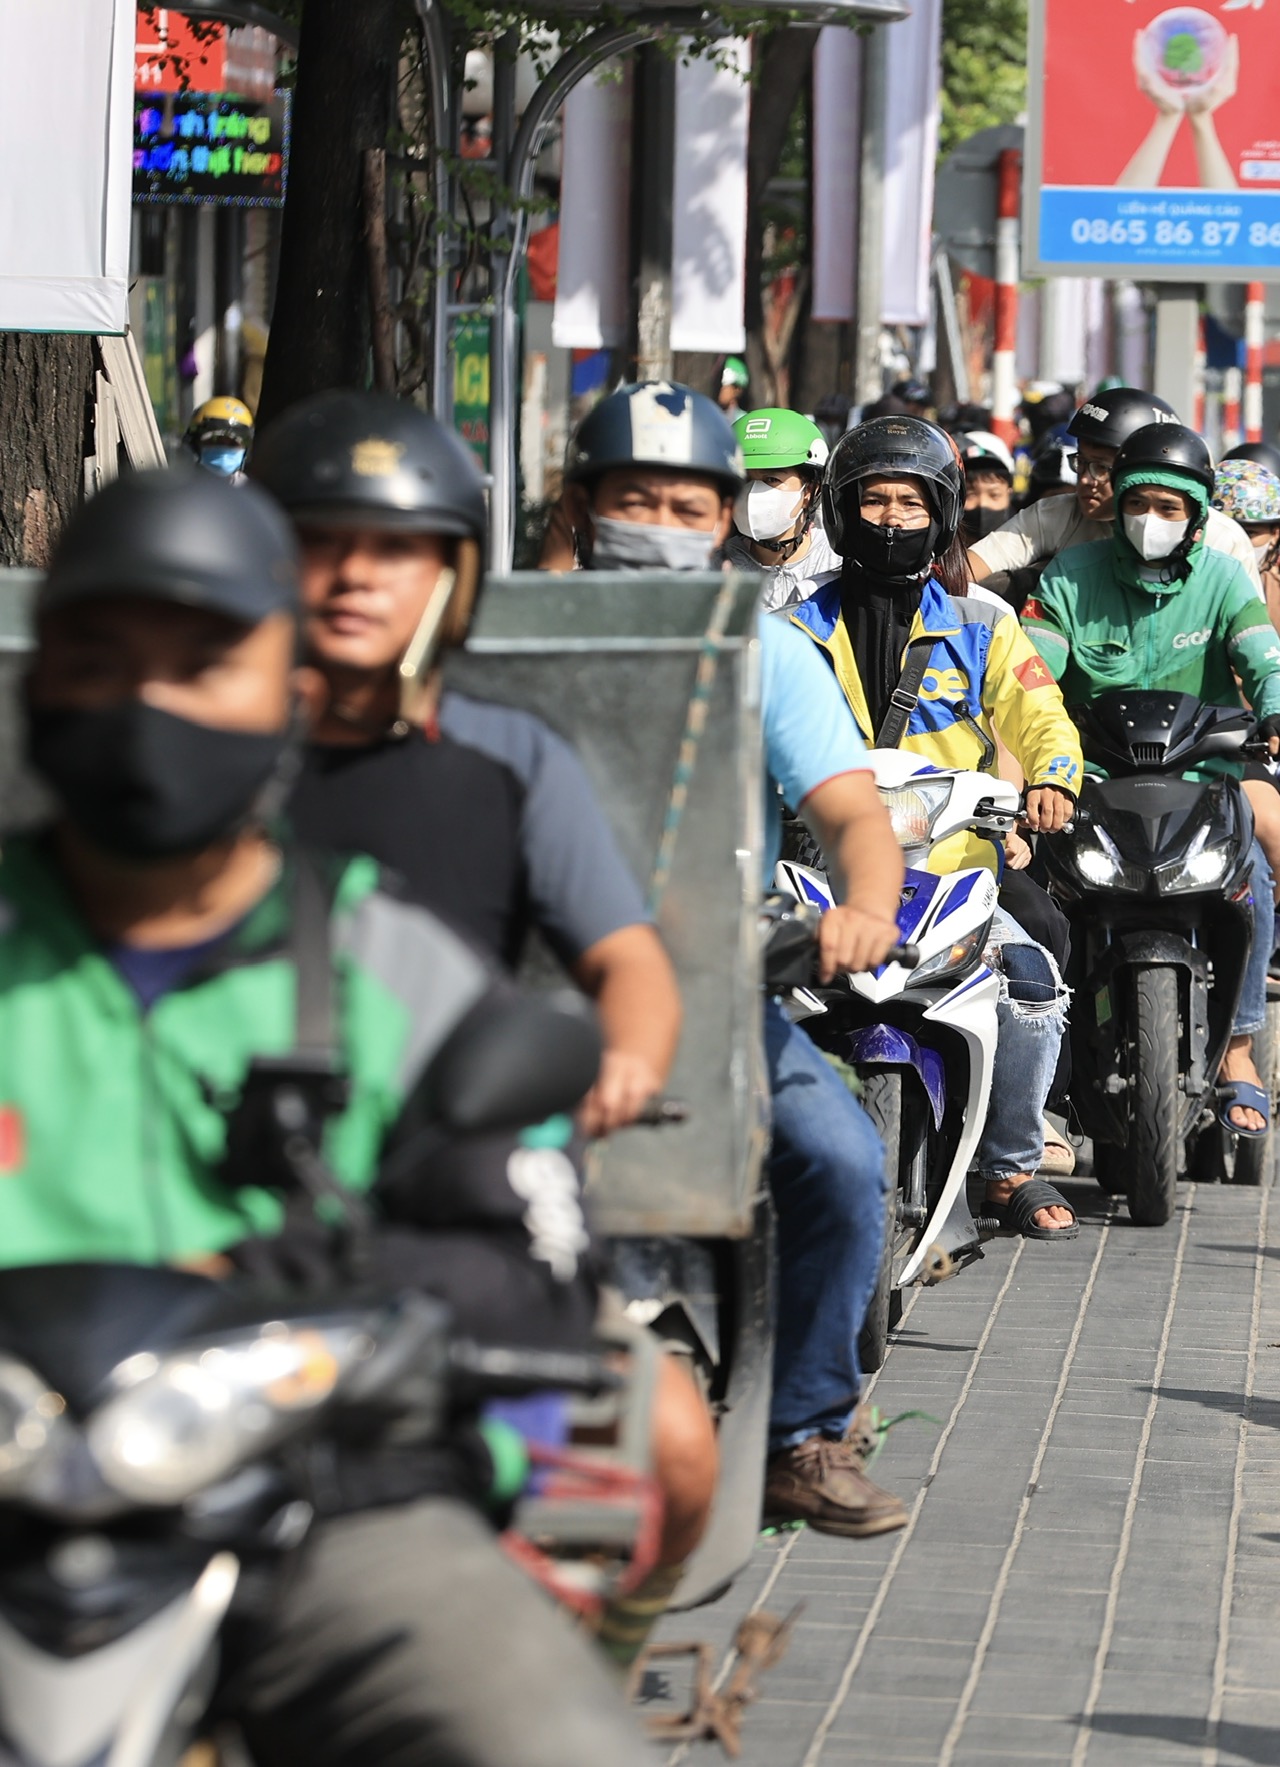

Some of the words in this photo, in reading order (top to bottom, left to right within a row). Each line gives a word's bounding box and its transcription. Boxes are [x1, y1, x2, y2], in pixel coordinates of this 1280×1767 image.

[1071, 218, 1147, 245] 0865
[1154, 220, 1194, 246] 86
[1202, 221, 1241, 247] 87
